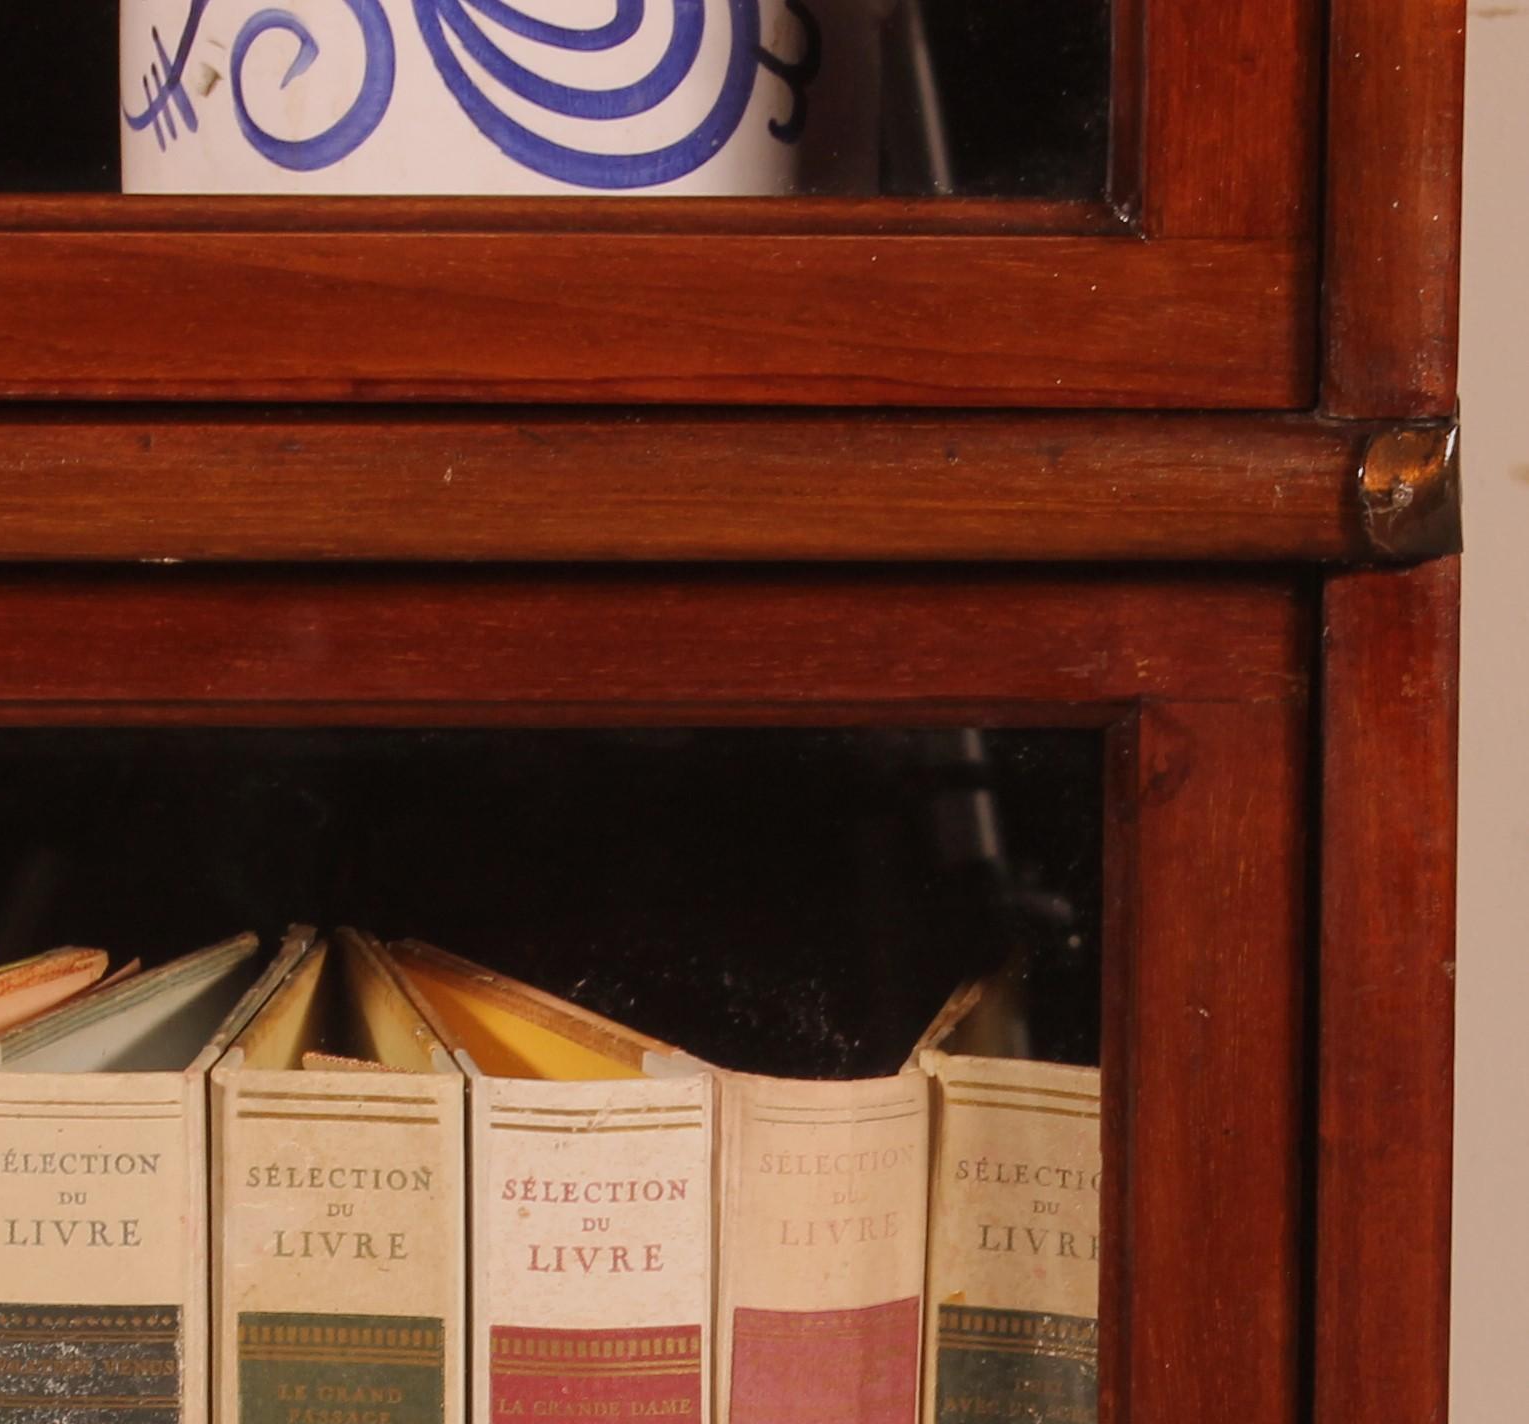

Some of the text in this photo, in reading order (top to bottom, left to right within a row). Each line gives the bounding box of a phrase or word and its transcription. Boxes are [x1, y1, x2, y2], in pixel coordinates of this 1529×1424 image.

[758, 1143, 915, 1176] SÉLECTION
[245, 1163, 433, 1191] SÉLECTION
[501, 1176, 688, 1203] SÉLECTION
[58, 1191, 87, 1206] DU
[327, 1203, 355, 1217] DU
[1031, 1199, 1060, 1215] DU
[4, 1218, 142, 1247] LIVRE
[581, 1217, 610, 1232] DU
[779, 1211, 901, 1247] LIVRE
[273, 1230, 409, 1260] LIVRE
[527, 1242, 665, 1273] LIVRE
[278, 1383, 403, 1404] LE GRAND
[496, 1399, 693, 1417] LA GRANDE DAME
